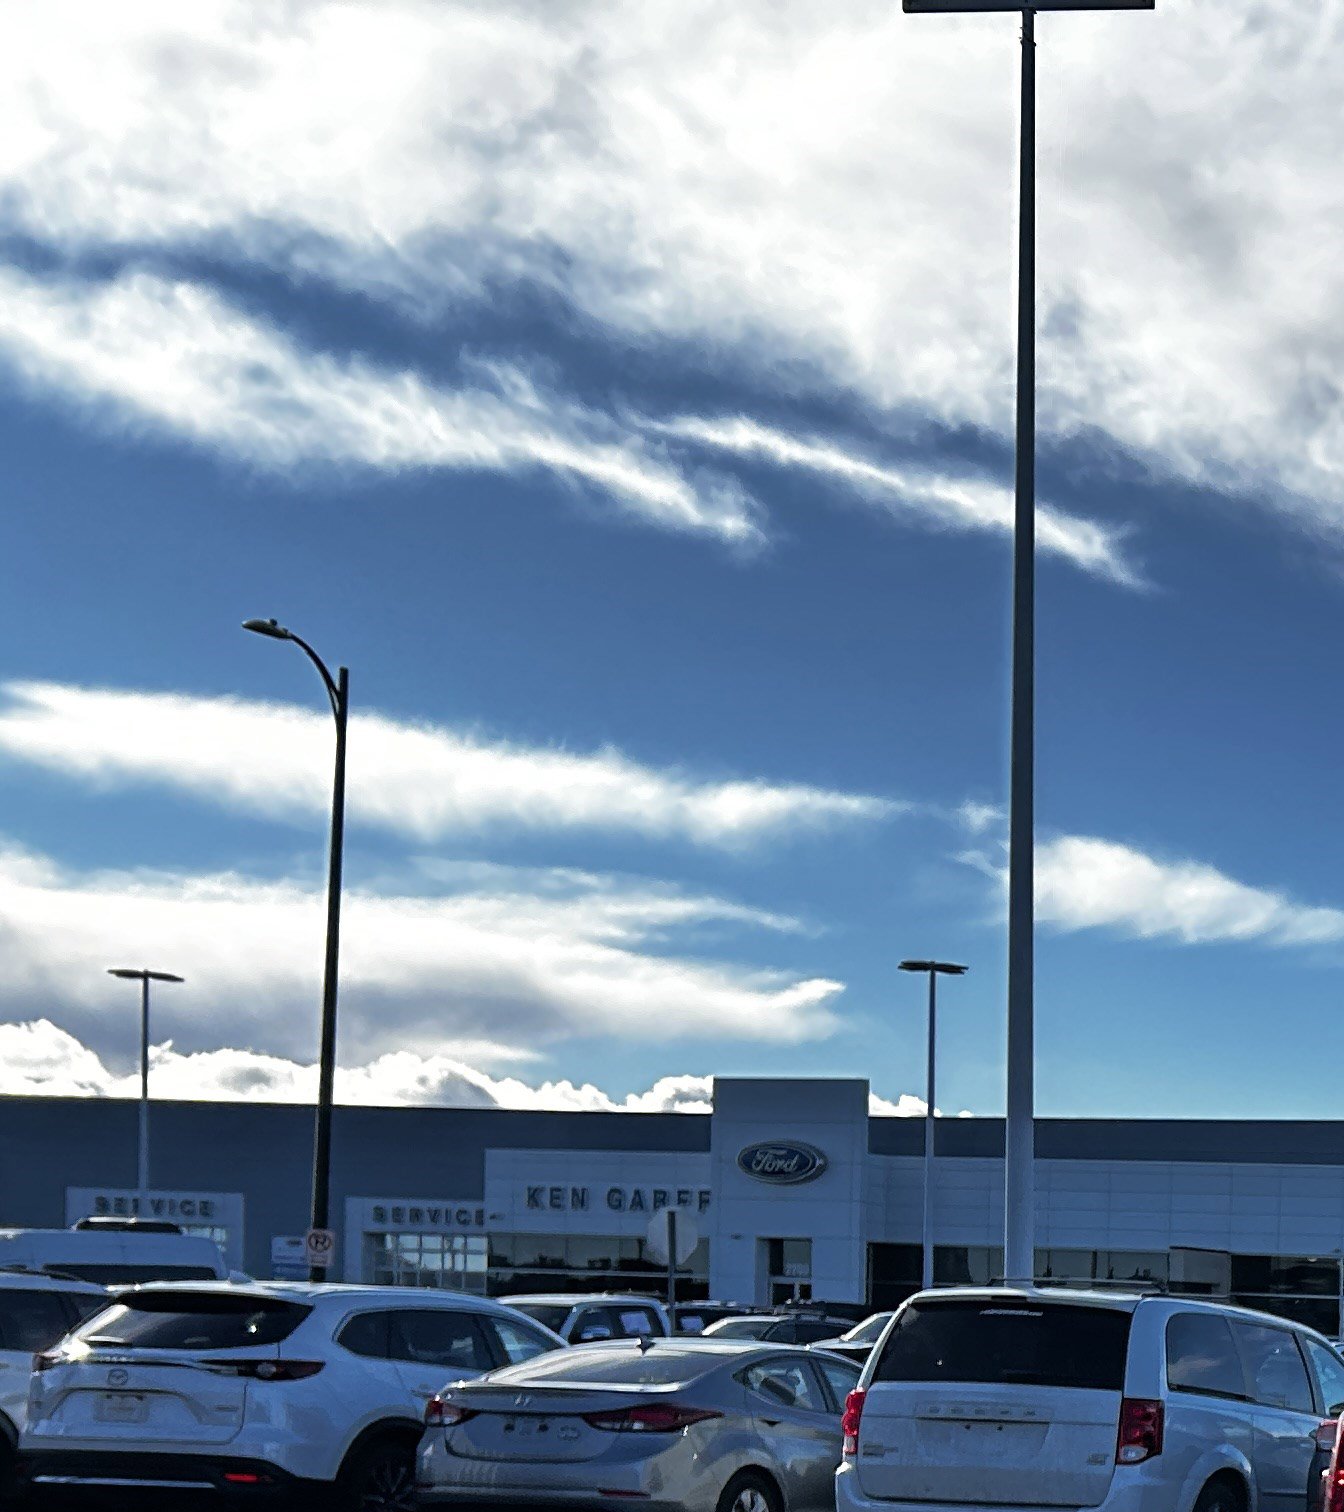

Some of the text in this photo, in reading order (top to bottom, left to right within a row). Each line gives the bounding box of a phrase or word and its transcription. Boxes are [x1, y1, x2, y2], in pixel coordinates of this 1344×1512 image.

[751, 1149, 800, 1172] Ford
[527, 1186, 711, 1212] KEN GARFF
